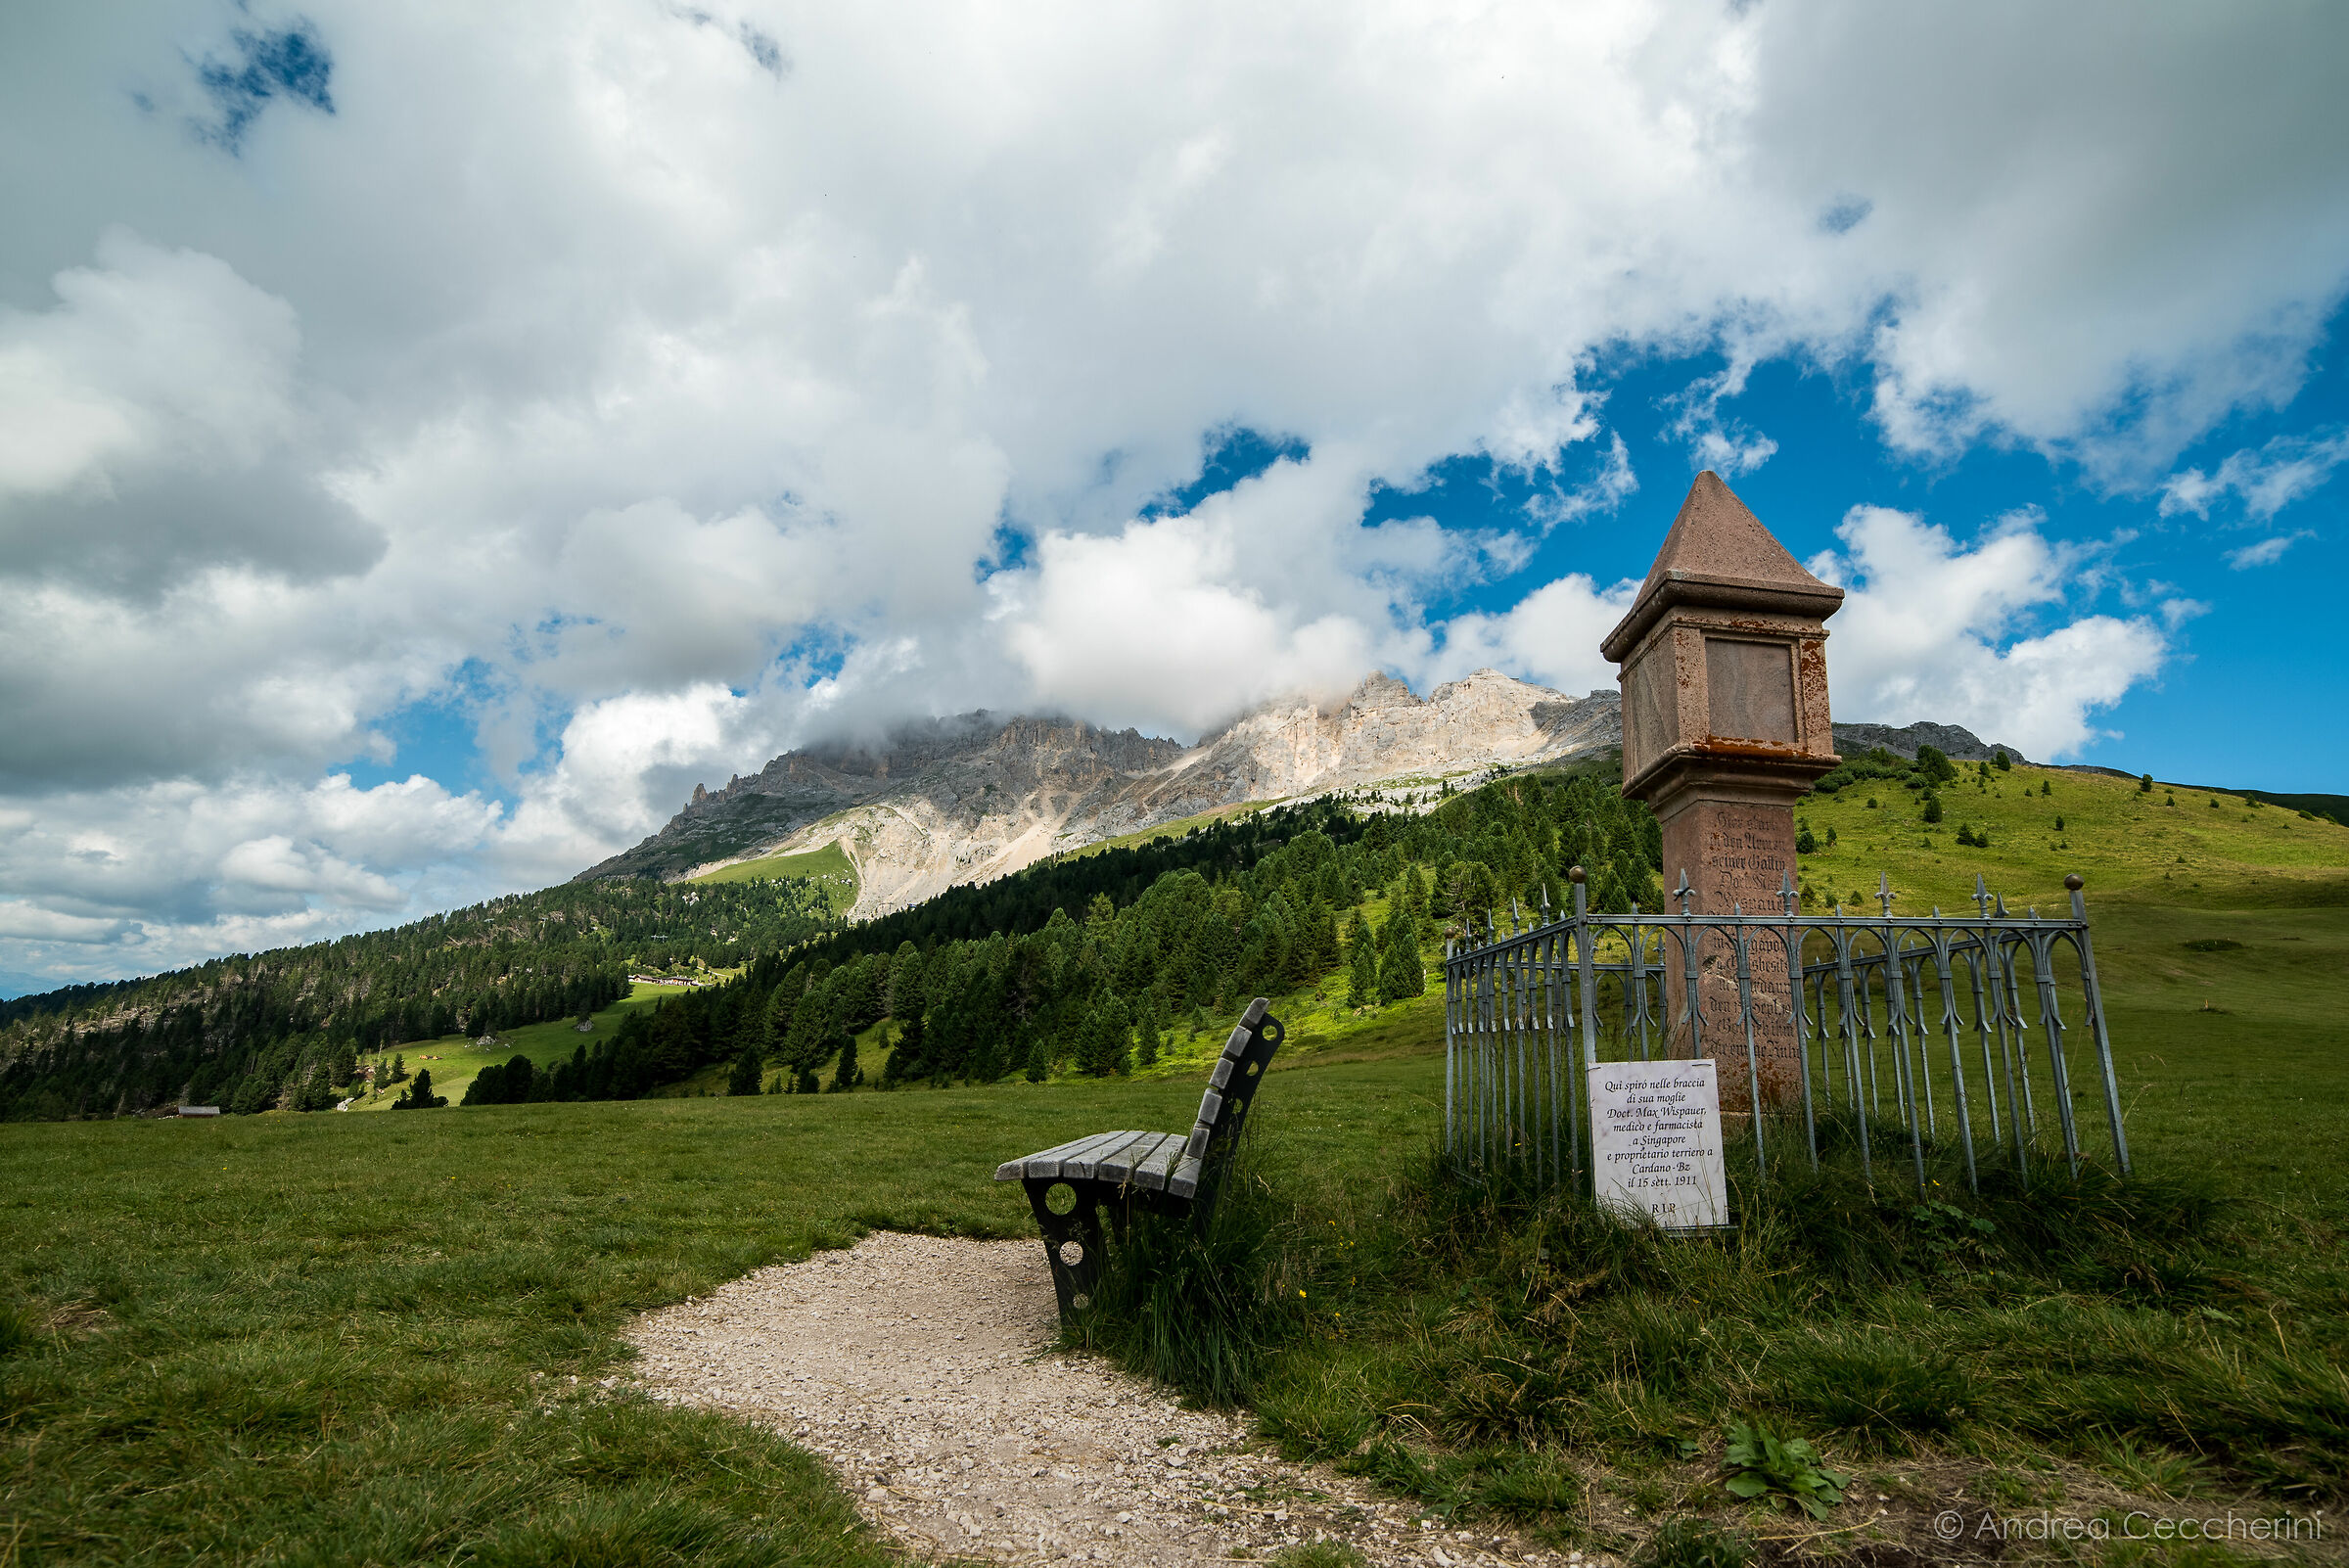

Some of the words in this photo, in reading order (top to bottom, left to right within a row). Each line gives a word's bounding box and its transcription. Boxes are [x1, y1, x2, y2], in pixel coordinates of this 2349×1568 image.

[1723, 832, 1743, 850] den
[1711, 853, 1746, 869] seiner
[1748, 853, 1785, 871] Gattin
[1709, 996, 1731, 1013] den
[1605, 1081, 1623, 1092] Qui
[1625, 1080, 1647, 1093] spiró
[1649, 1078, 1671, 1089] nelle
[1673, 1077, 1705, 1088] braccia
[1627, 1093, 1636, 1104] di
[1657, 1093, 1686, 1105] moglie
[1606, 1107, 1633, 1119] Doct.
[1635, 1107, 1659, 1119] Max
[1660, 1105, 1707, 1120] Wispauer,
[1613, 1121, 1645, 1132] medico
[1653, 1120, 1703, 1133] farmacista
[1639, 1135, 1686, 1148] Singapore
[1614, 1149, 1670, 1163] proprietario
[1672, 1149, 1705, 1158] terriero
[1628, 1176, 1635, 1188] il
[1637, 1177, 1648, 1188] 15
[1650, 1176, 1672, 1187] sett.
[1675, 1176, 1697, 1186] 1911
